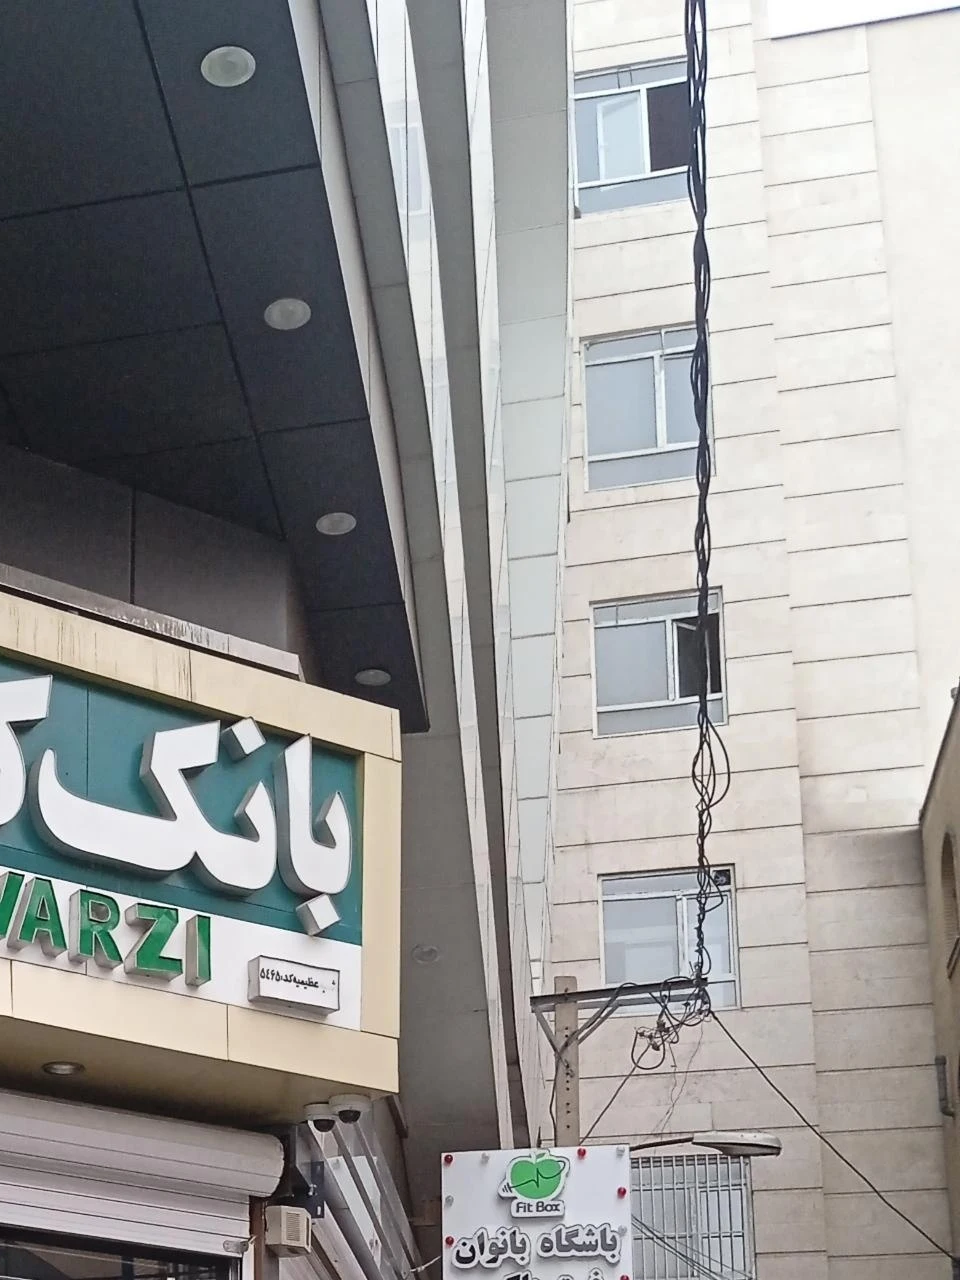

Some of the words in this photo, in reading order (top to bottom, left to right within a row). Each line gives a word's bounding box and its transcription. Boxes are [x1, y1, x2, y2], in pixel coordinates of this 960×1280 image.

[33, 717, 352, 936] بانک
[516, 1202, 533, 1213] Fit
[536, 1201, 561, 1213] Box
[455, 1229, 528, 1264] بانوان
[540, 1226, 618, 1259] باشگاه
